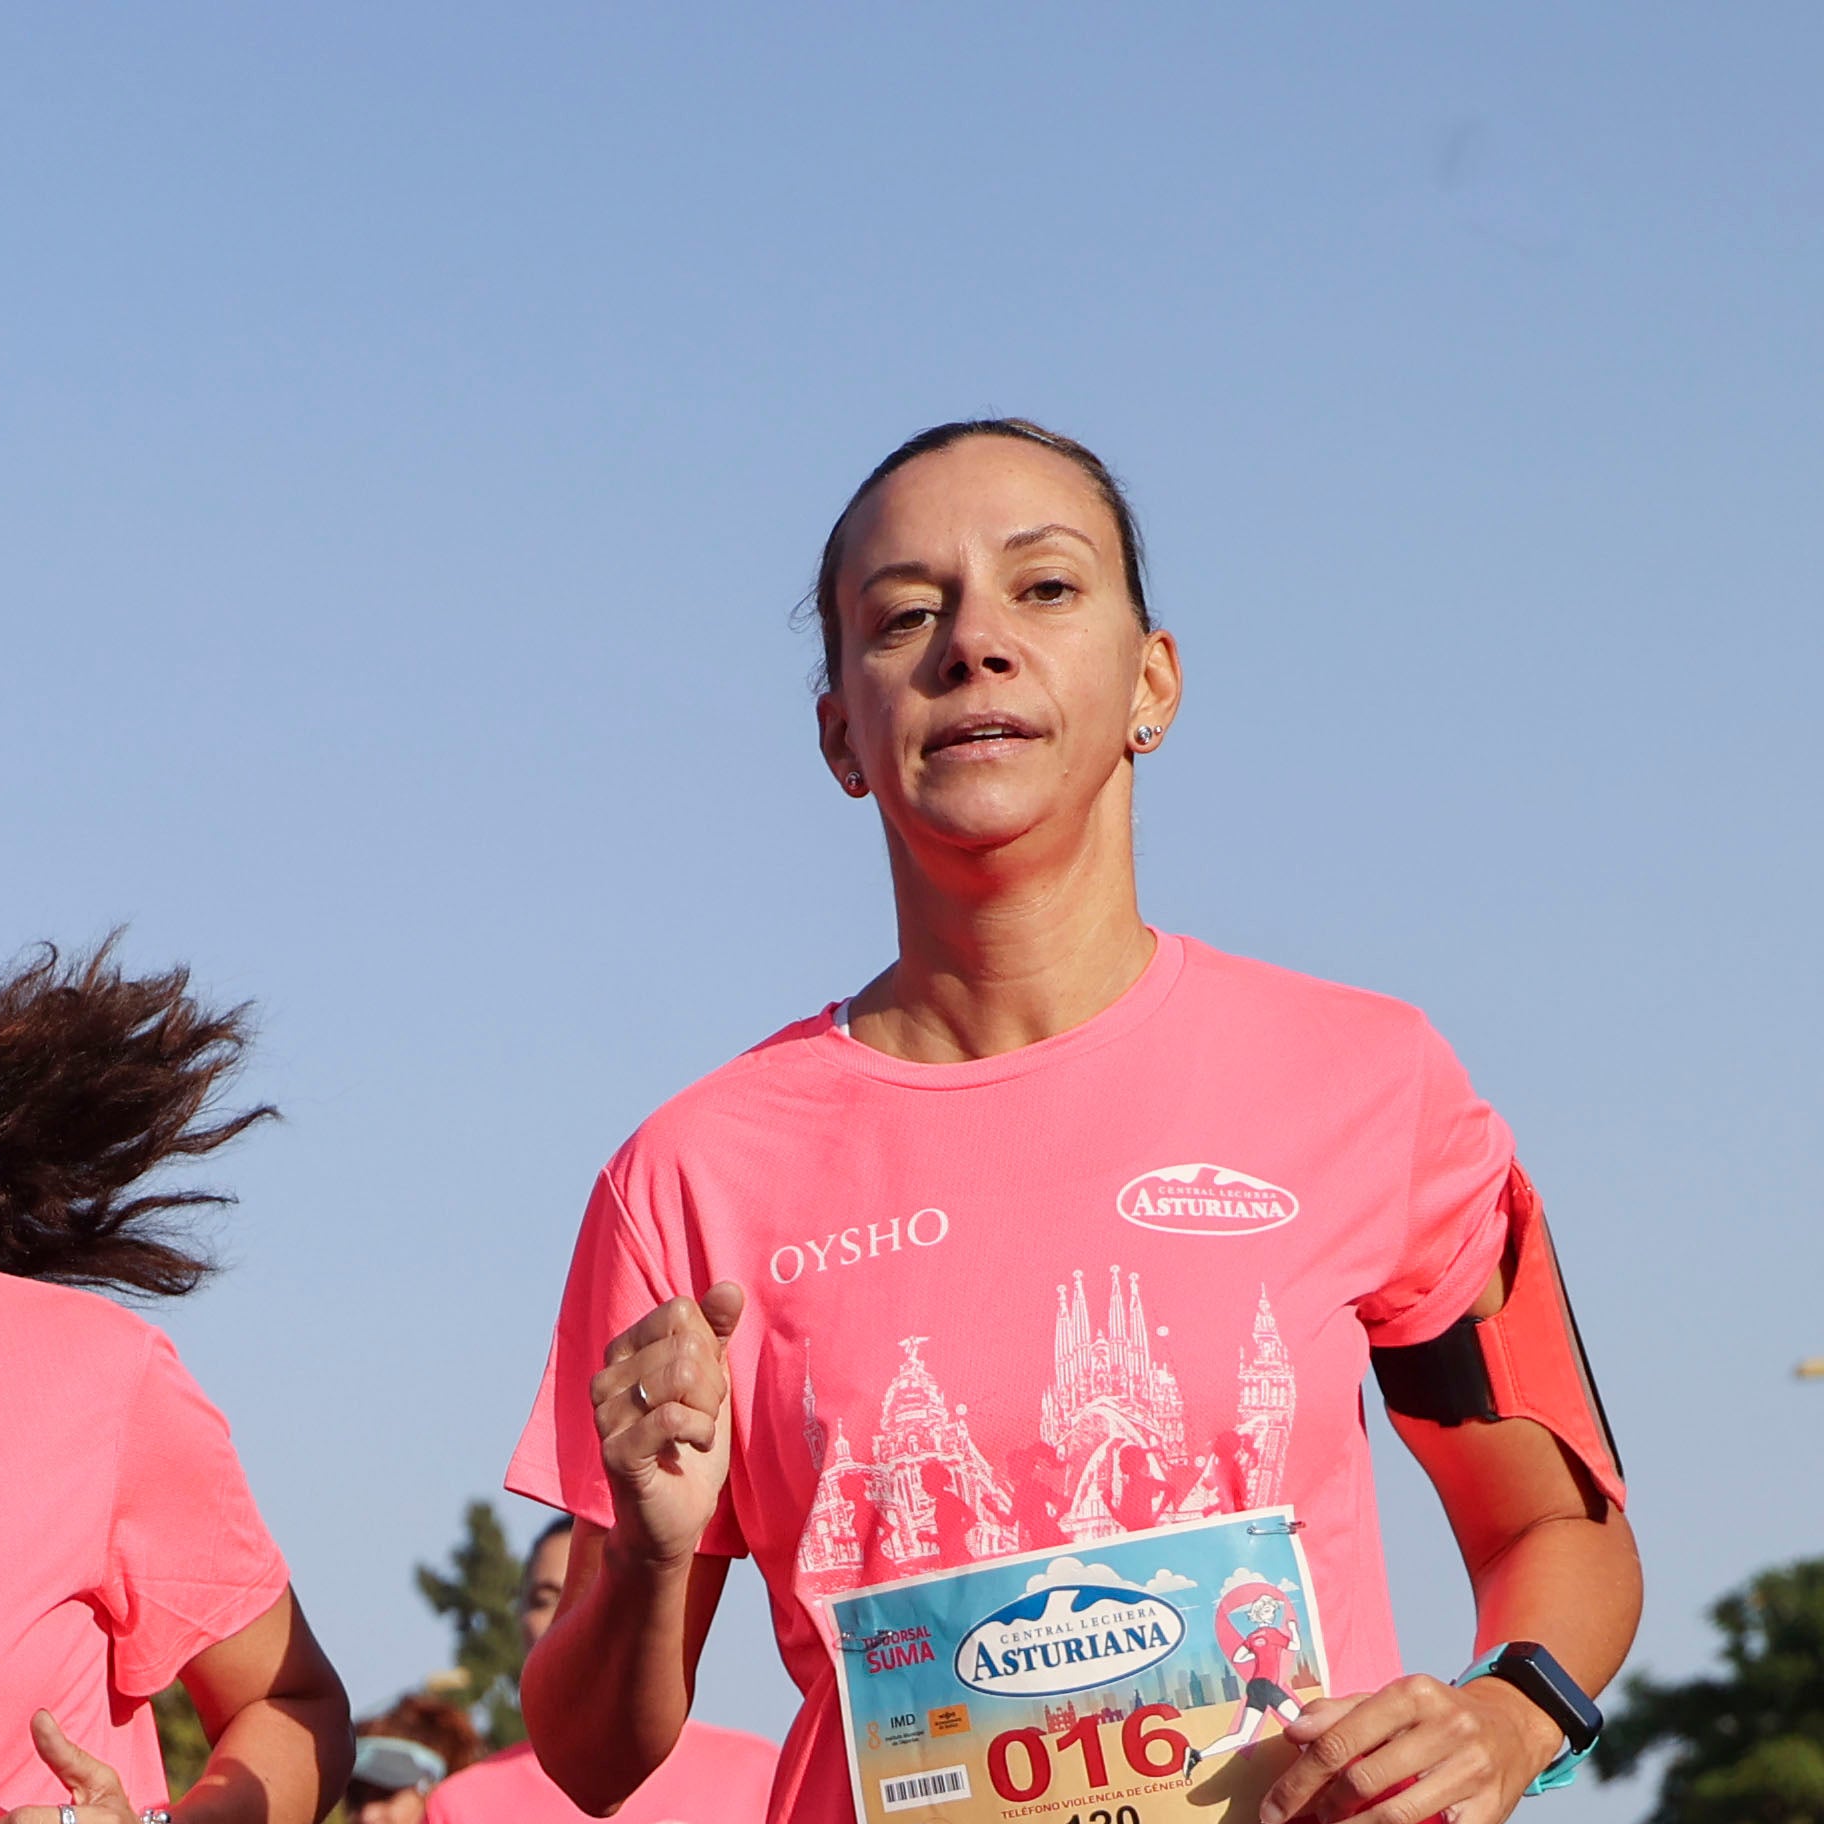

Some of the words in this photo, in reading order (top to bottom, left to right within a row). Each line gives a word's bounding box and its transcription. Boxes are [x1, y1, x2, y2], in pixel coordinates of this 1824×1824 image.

[1131, 1187, 1286, 1219] ASTURIANA
[1158, 1186, 1215, 1196] CENTRAL
[1219, 1189, 1277, 1199] LECHERA
[770, 1207, 949, 1285] OYSHO
[1000, 1623, 1073, 1644] CENTRAL
[1080, 1607, 1157, 1629] LECHERA
[867, 1641, 935, 1674] SUMA
[972, 1621, 1170, 1682] ASTURIANA
[890, 1713, 916, 1729] IMD
[987, 1703, 1191, 1802] 016
[1001, 1802, 1060, 1819] TELÉFONO
[1062, 1791, 1125, 1808] VIOLENCIA
[1127, 1787, 1141, 1798] DE
[1144, 1777, 1193, 1794] GÉNERO
